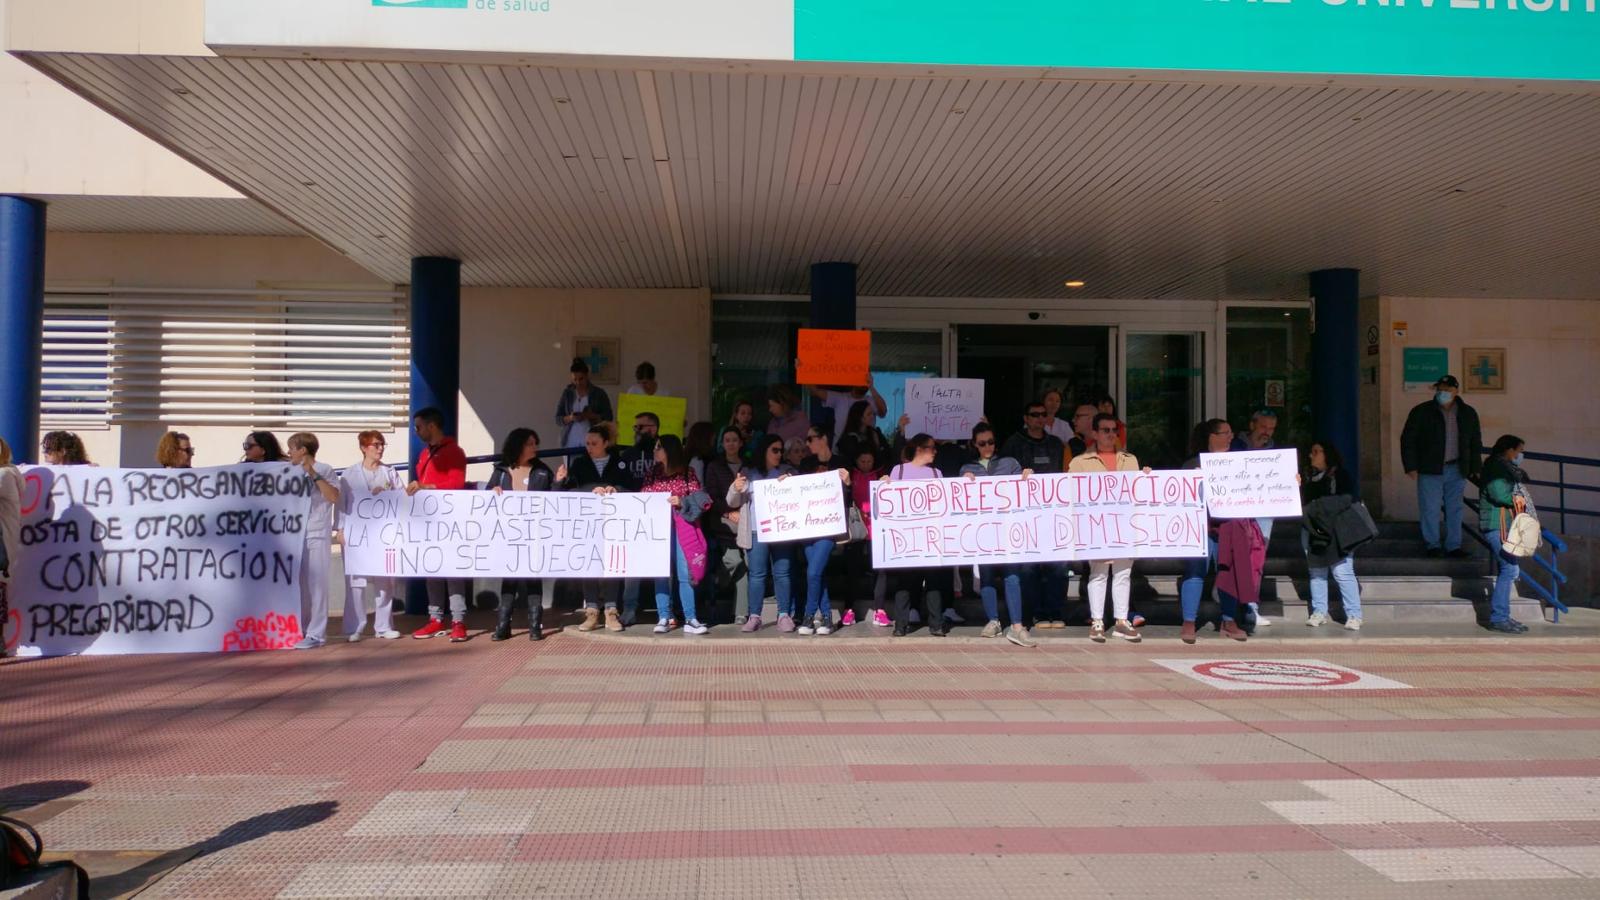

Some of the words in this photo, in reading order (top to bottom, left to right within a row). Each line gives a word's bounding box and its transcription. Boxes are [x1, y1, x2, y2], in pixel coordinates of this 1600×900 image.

[925, 416, 972, 434] MATA
[46, 473, 76, 510] A
[83, 477, 113, 507] LA
[1210, 484, 1227, 496] NO
[357, 497, 398, 519] CON
[410, 494, 454, 516] LOS
[470, 495, 617, 516] PACIENTES
[633, 496, 652, 514] Y
[90, 517, 123, 542] DE
[135, 513, 206, 541] OTROS
[348, 524, 369, 547] LA
[380, 520, 483, 545] CALIDAD
[491, 518, 667, 541] ASISTENCIAL
[456, 545, 490, 571] SE
